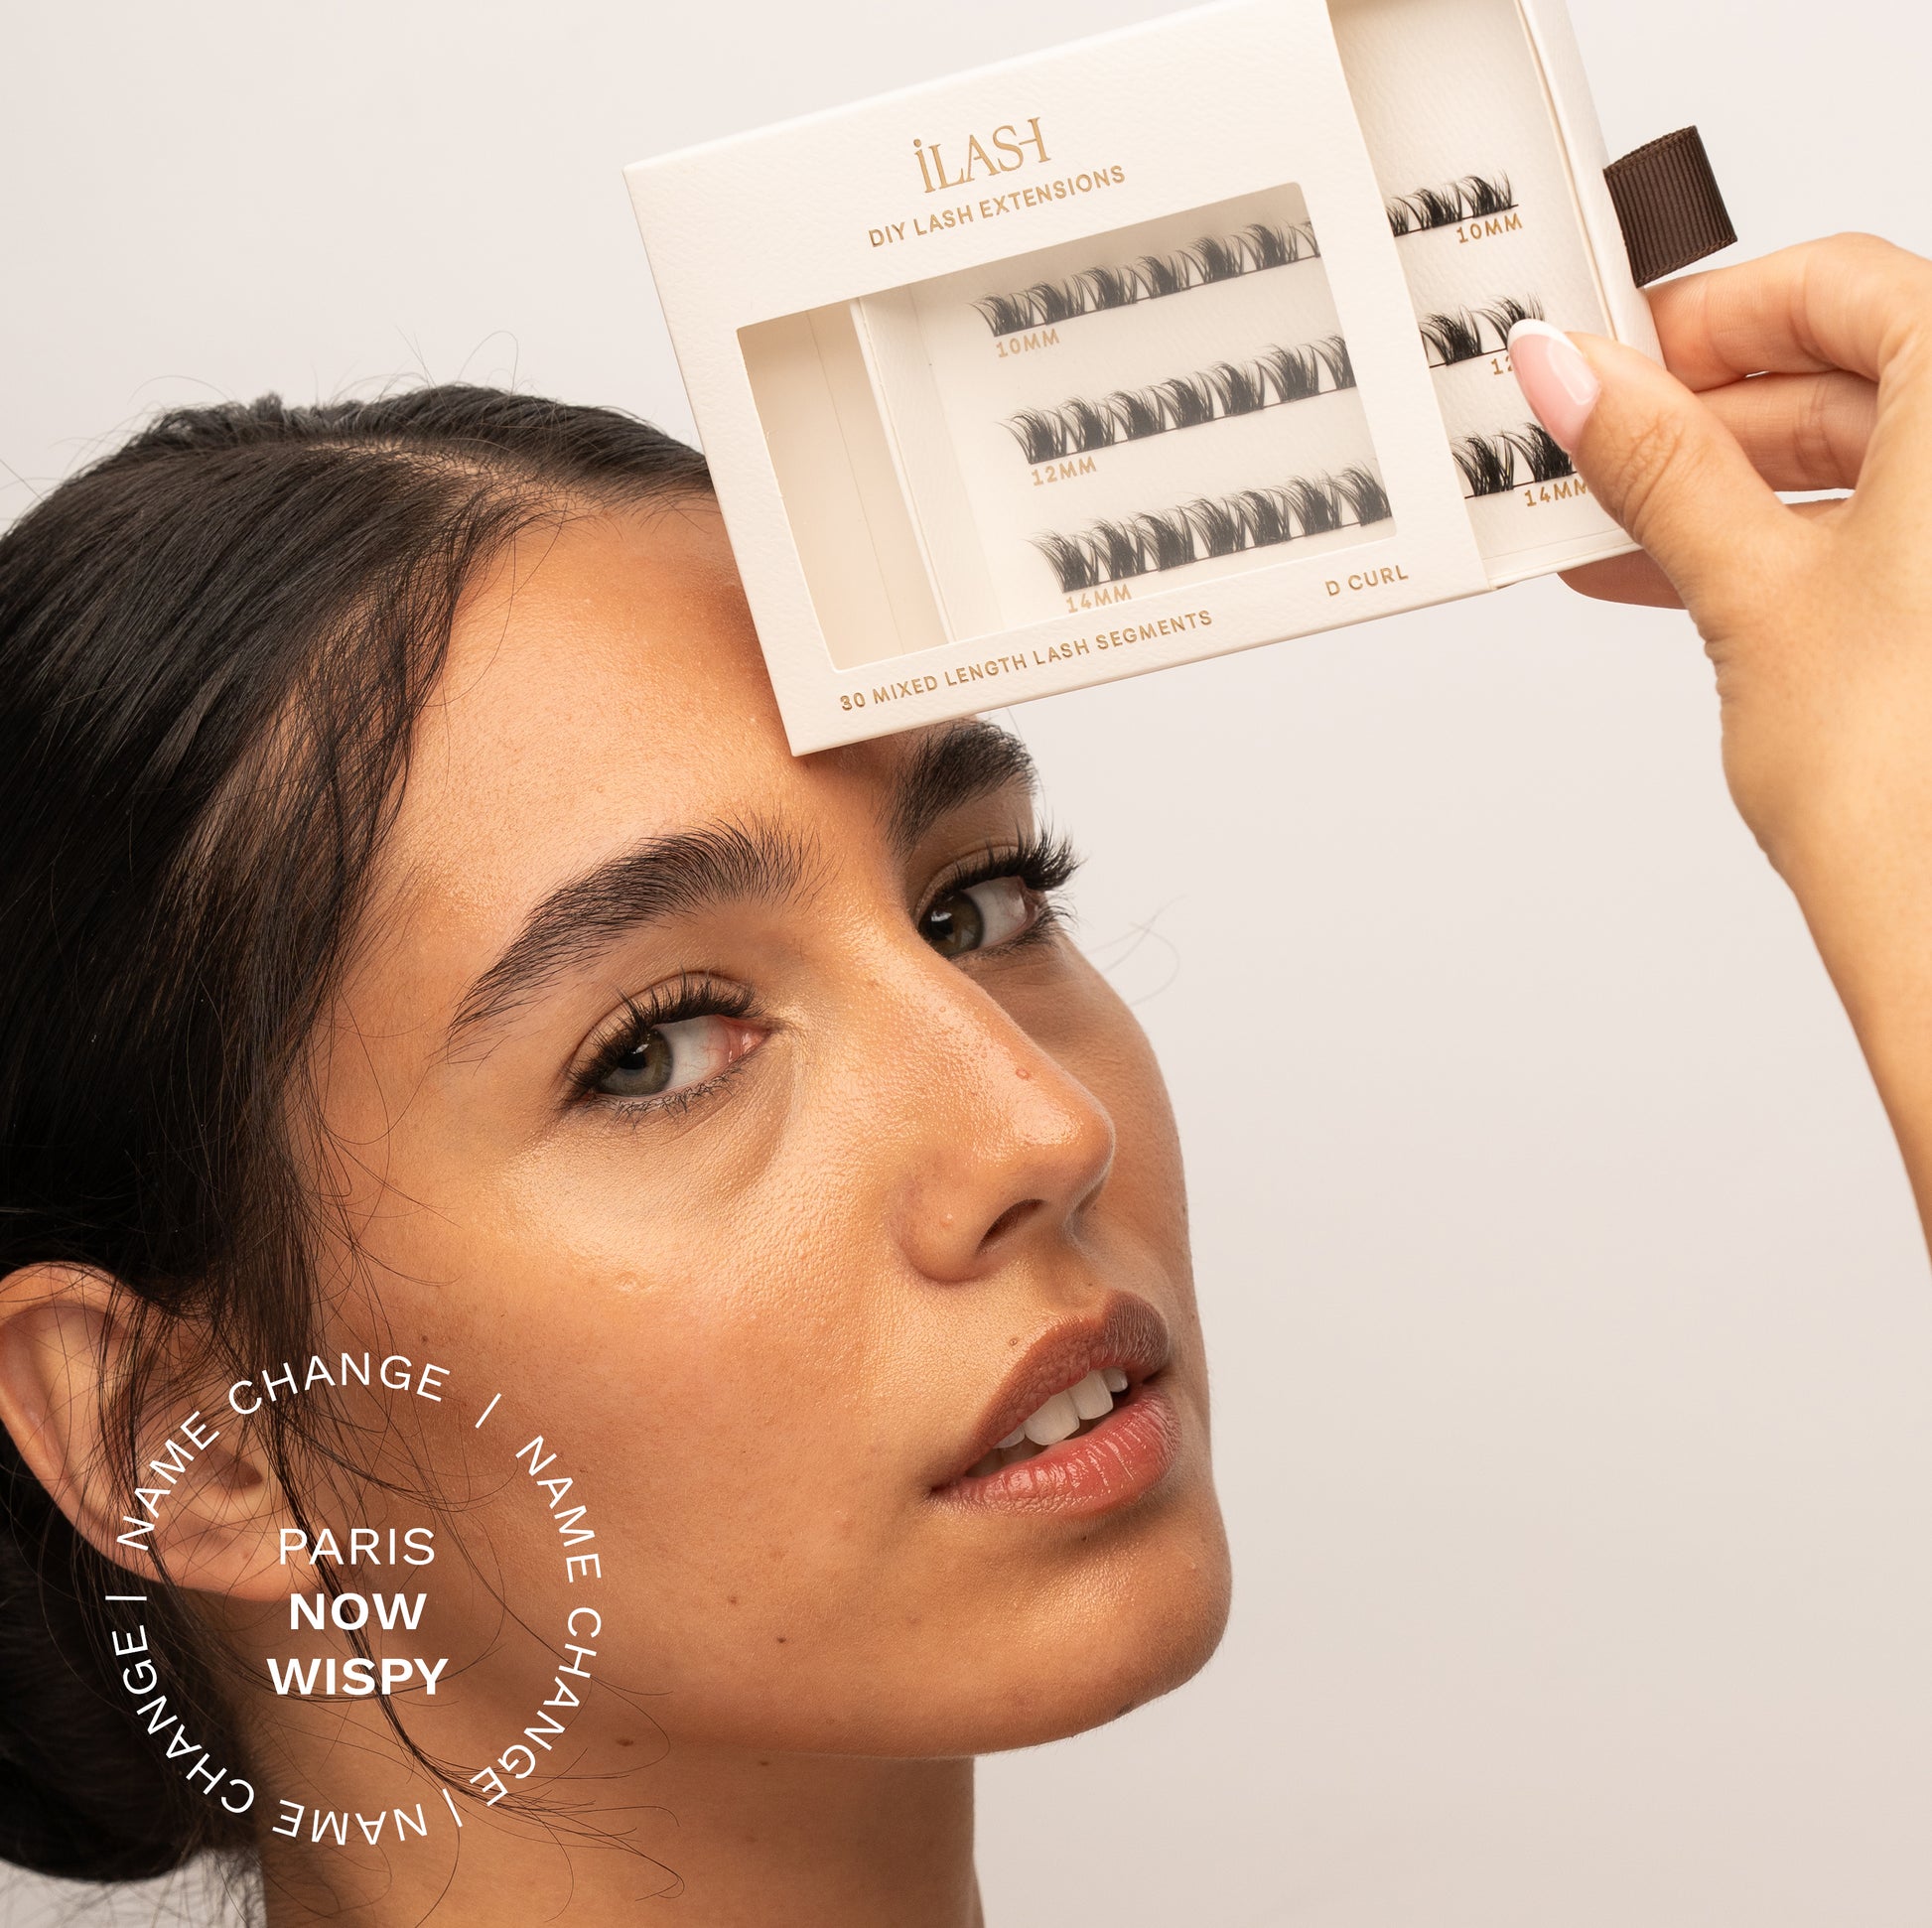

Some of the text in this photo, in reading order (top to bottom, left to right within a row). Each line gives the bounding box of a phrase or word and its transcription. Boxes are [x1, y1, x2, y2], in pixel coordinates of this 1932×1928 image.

[868, 165, 1127, 248] DIY LASH EXTENSIONS
[1455, 211, 1524, 244] 10MM
[995, 328, 1061, 358] 10MM
[1031, 455, 1097, 486] 12MM
[1324, 563, 1410, 597] D CURL
[1065, 583, 1133, 614] 14MM
[839, 609, 1213, 712] 30 MIXED LENGTH LASH SEGMENTS
